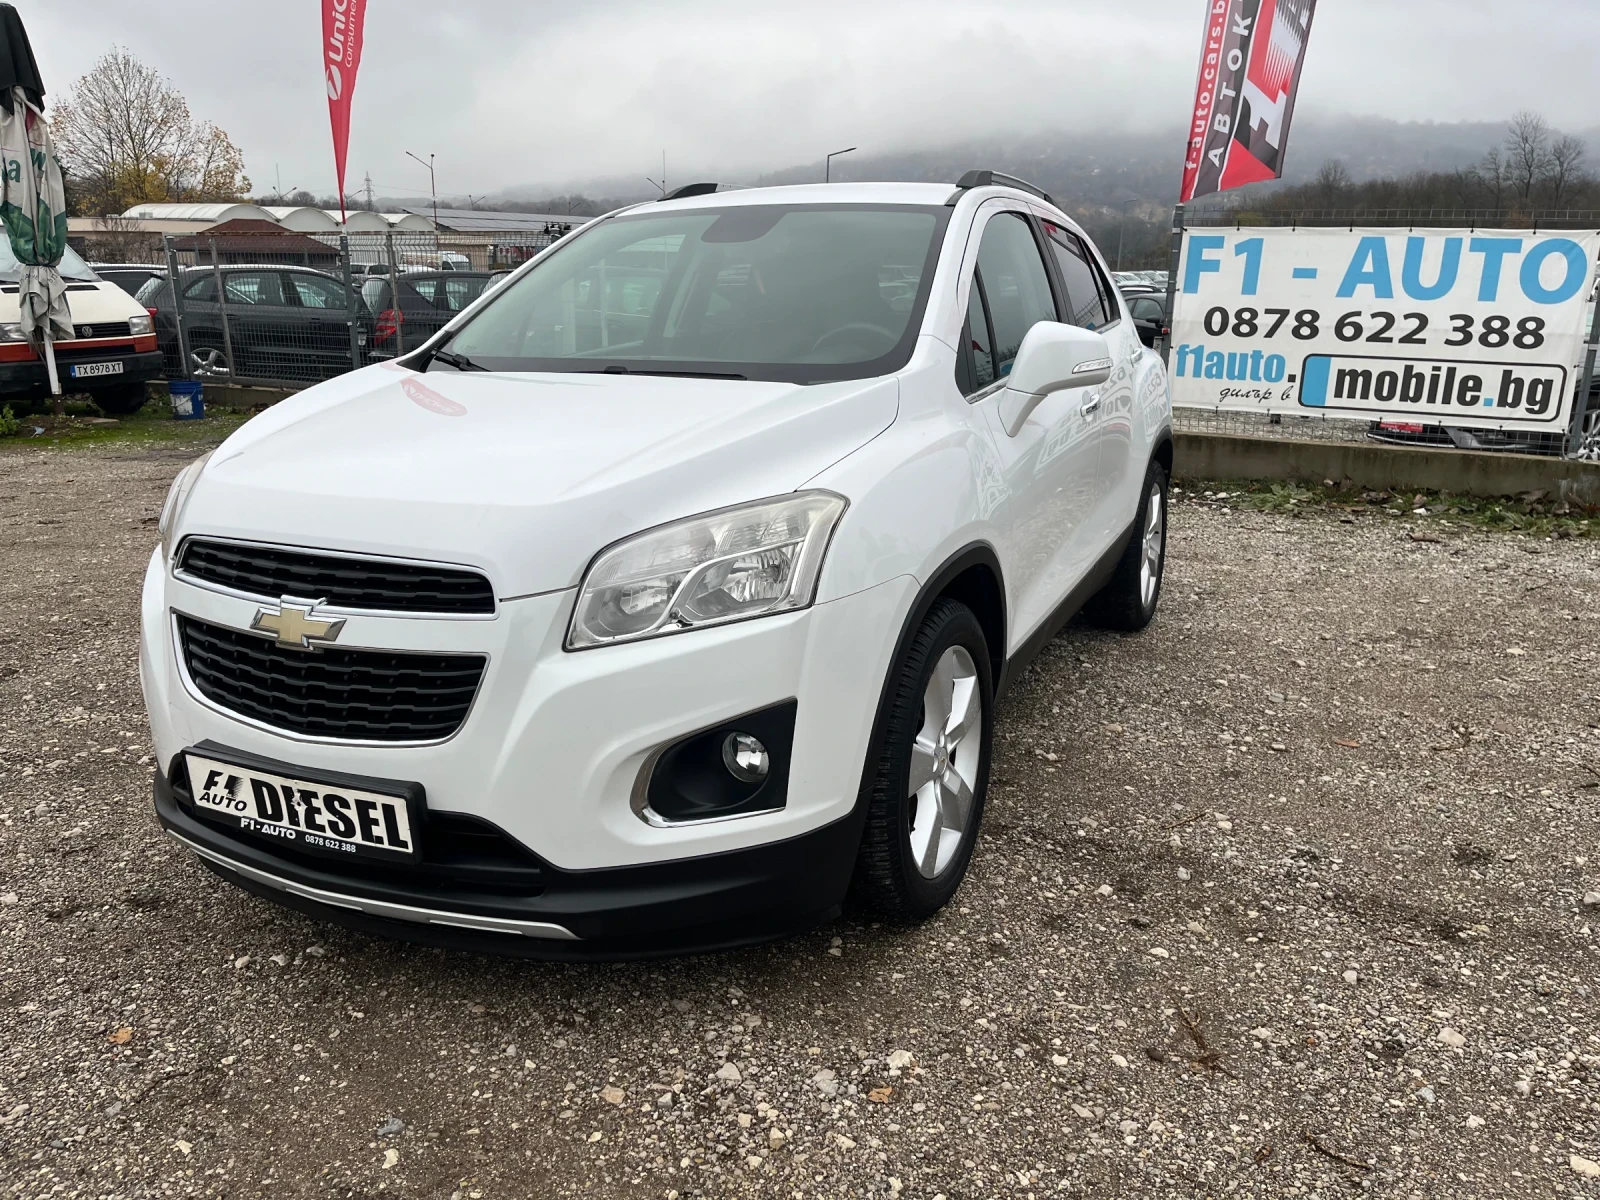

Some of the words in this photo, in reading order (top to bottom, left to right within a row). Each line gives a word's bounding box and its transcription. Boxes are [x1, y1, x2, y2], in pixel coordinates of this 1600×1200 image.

[1182, 235, 1265, 296] F1
[1335, 236, 1588, 305] AUTO
[1203, 306, 1320, 340] 0878
[1334, 310, 1430, 345] 622
[1444, 313, 1546, 349] 388
[76, 366, 89, 376] TX
[89, 364, 110, 375] 8978
[110, 362, 122, 373] XT
[1333, 364, 1554, 415] mobile.bg
[198, 791, 248, 812] AUTO
[249, 777, 409, 850] DIESEL
[305, 834, 324, 846] 0878
[325, 839, 340, 850] 622
[341, 842, 357, 853] 388
